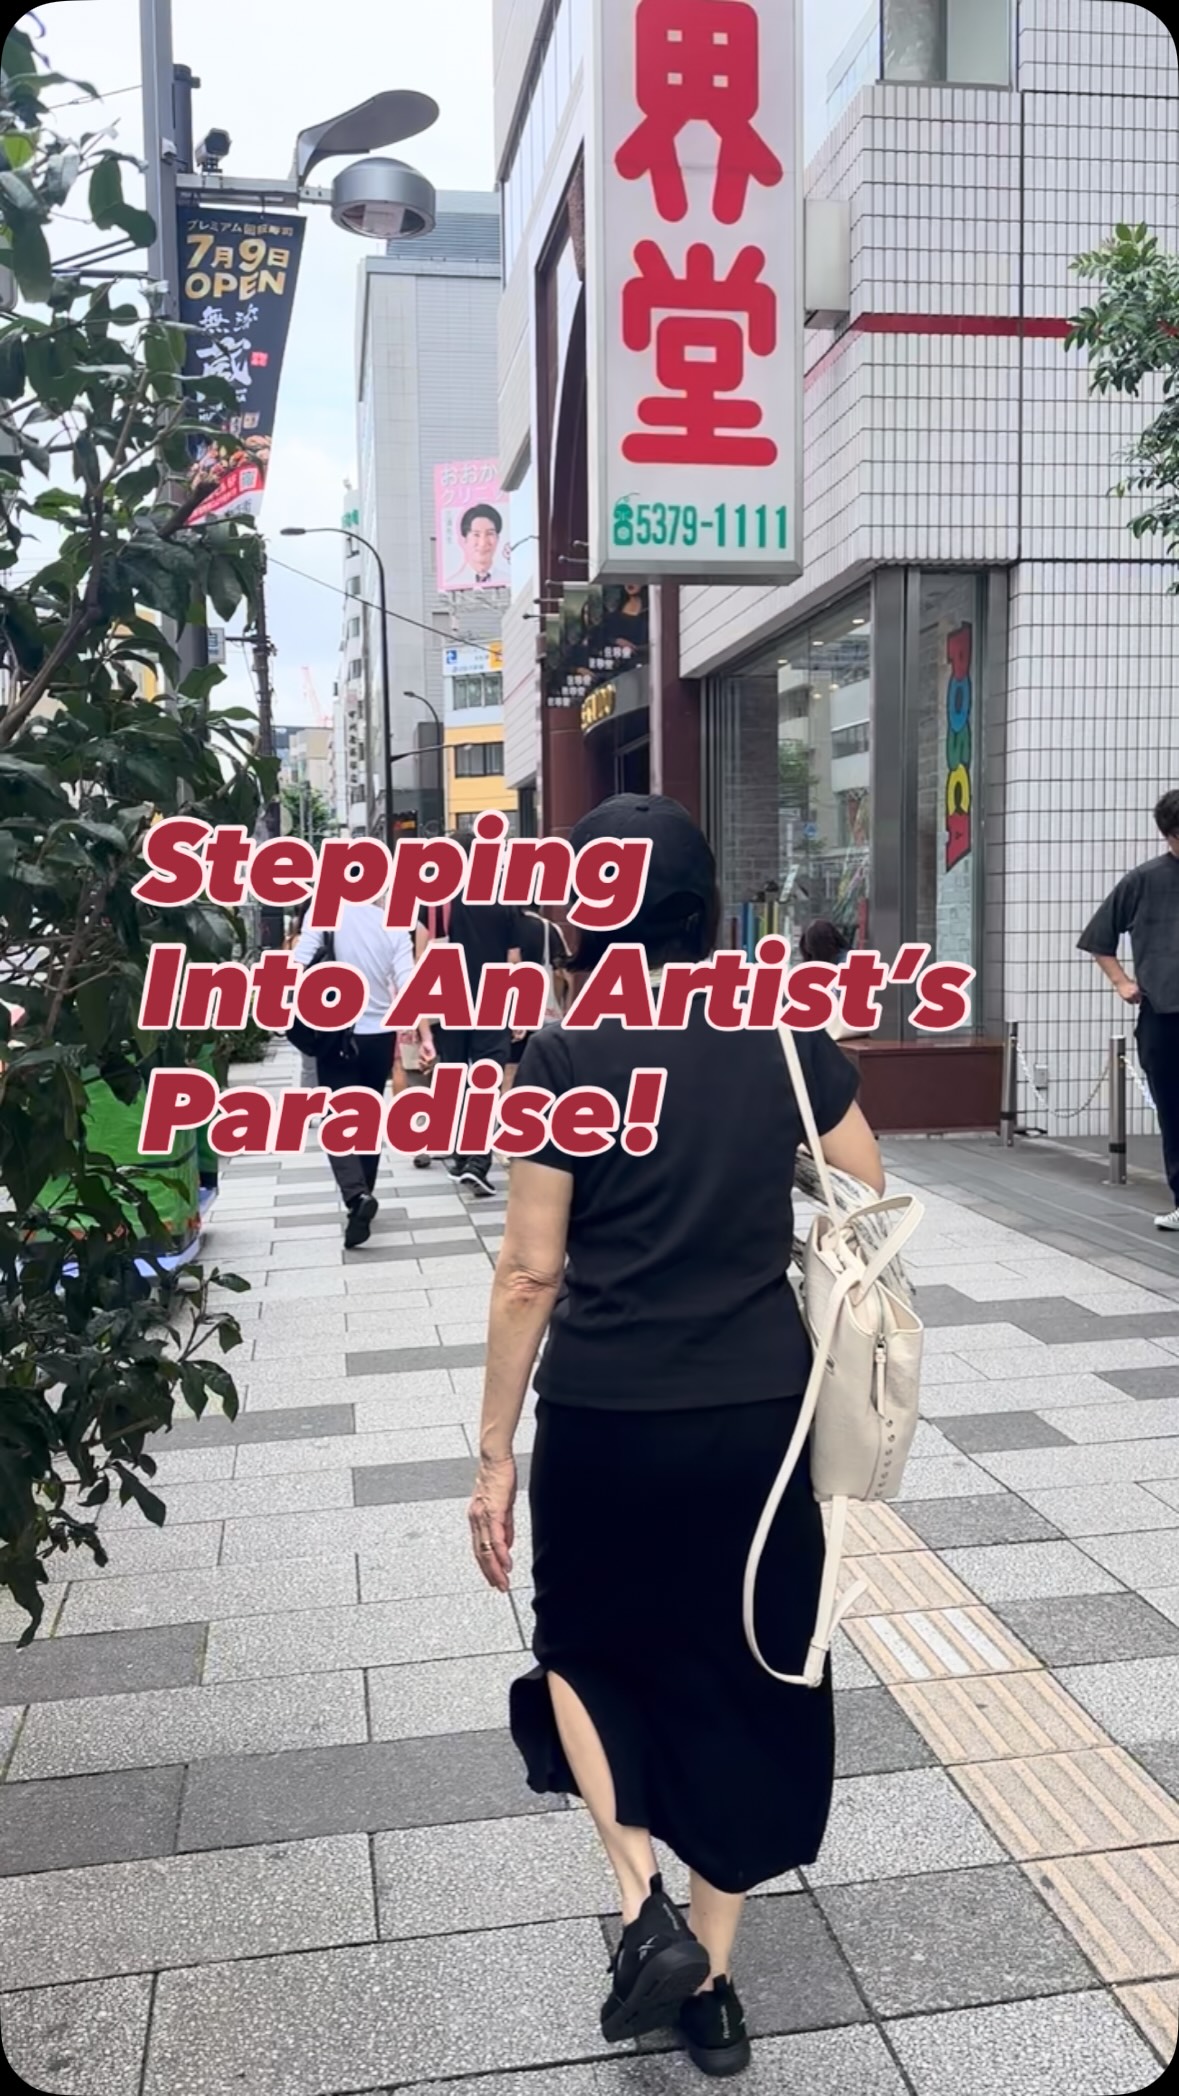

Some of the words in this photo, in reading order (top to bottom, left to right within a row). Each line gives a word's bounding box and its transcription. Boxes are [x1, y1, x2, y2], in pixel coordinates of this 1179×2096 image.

[186, 234, 290, 272] 7月9日
[185, 270, 286, 301] OPEN
[636, 502, 787, 549] 5379-1111
